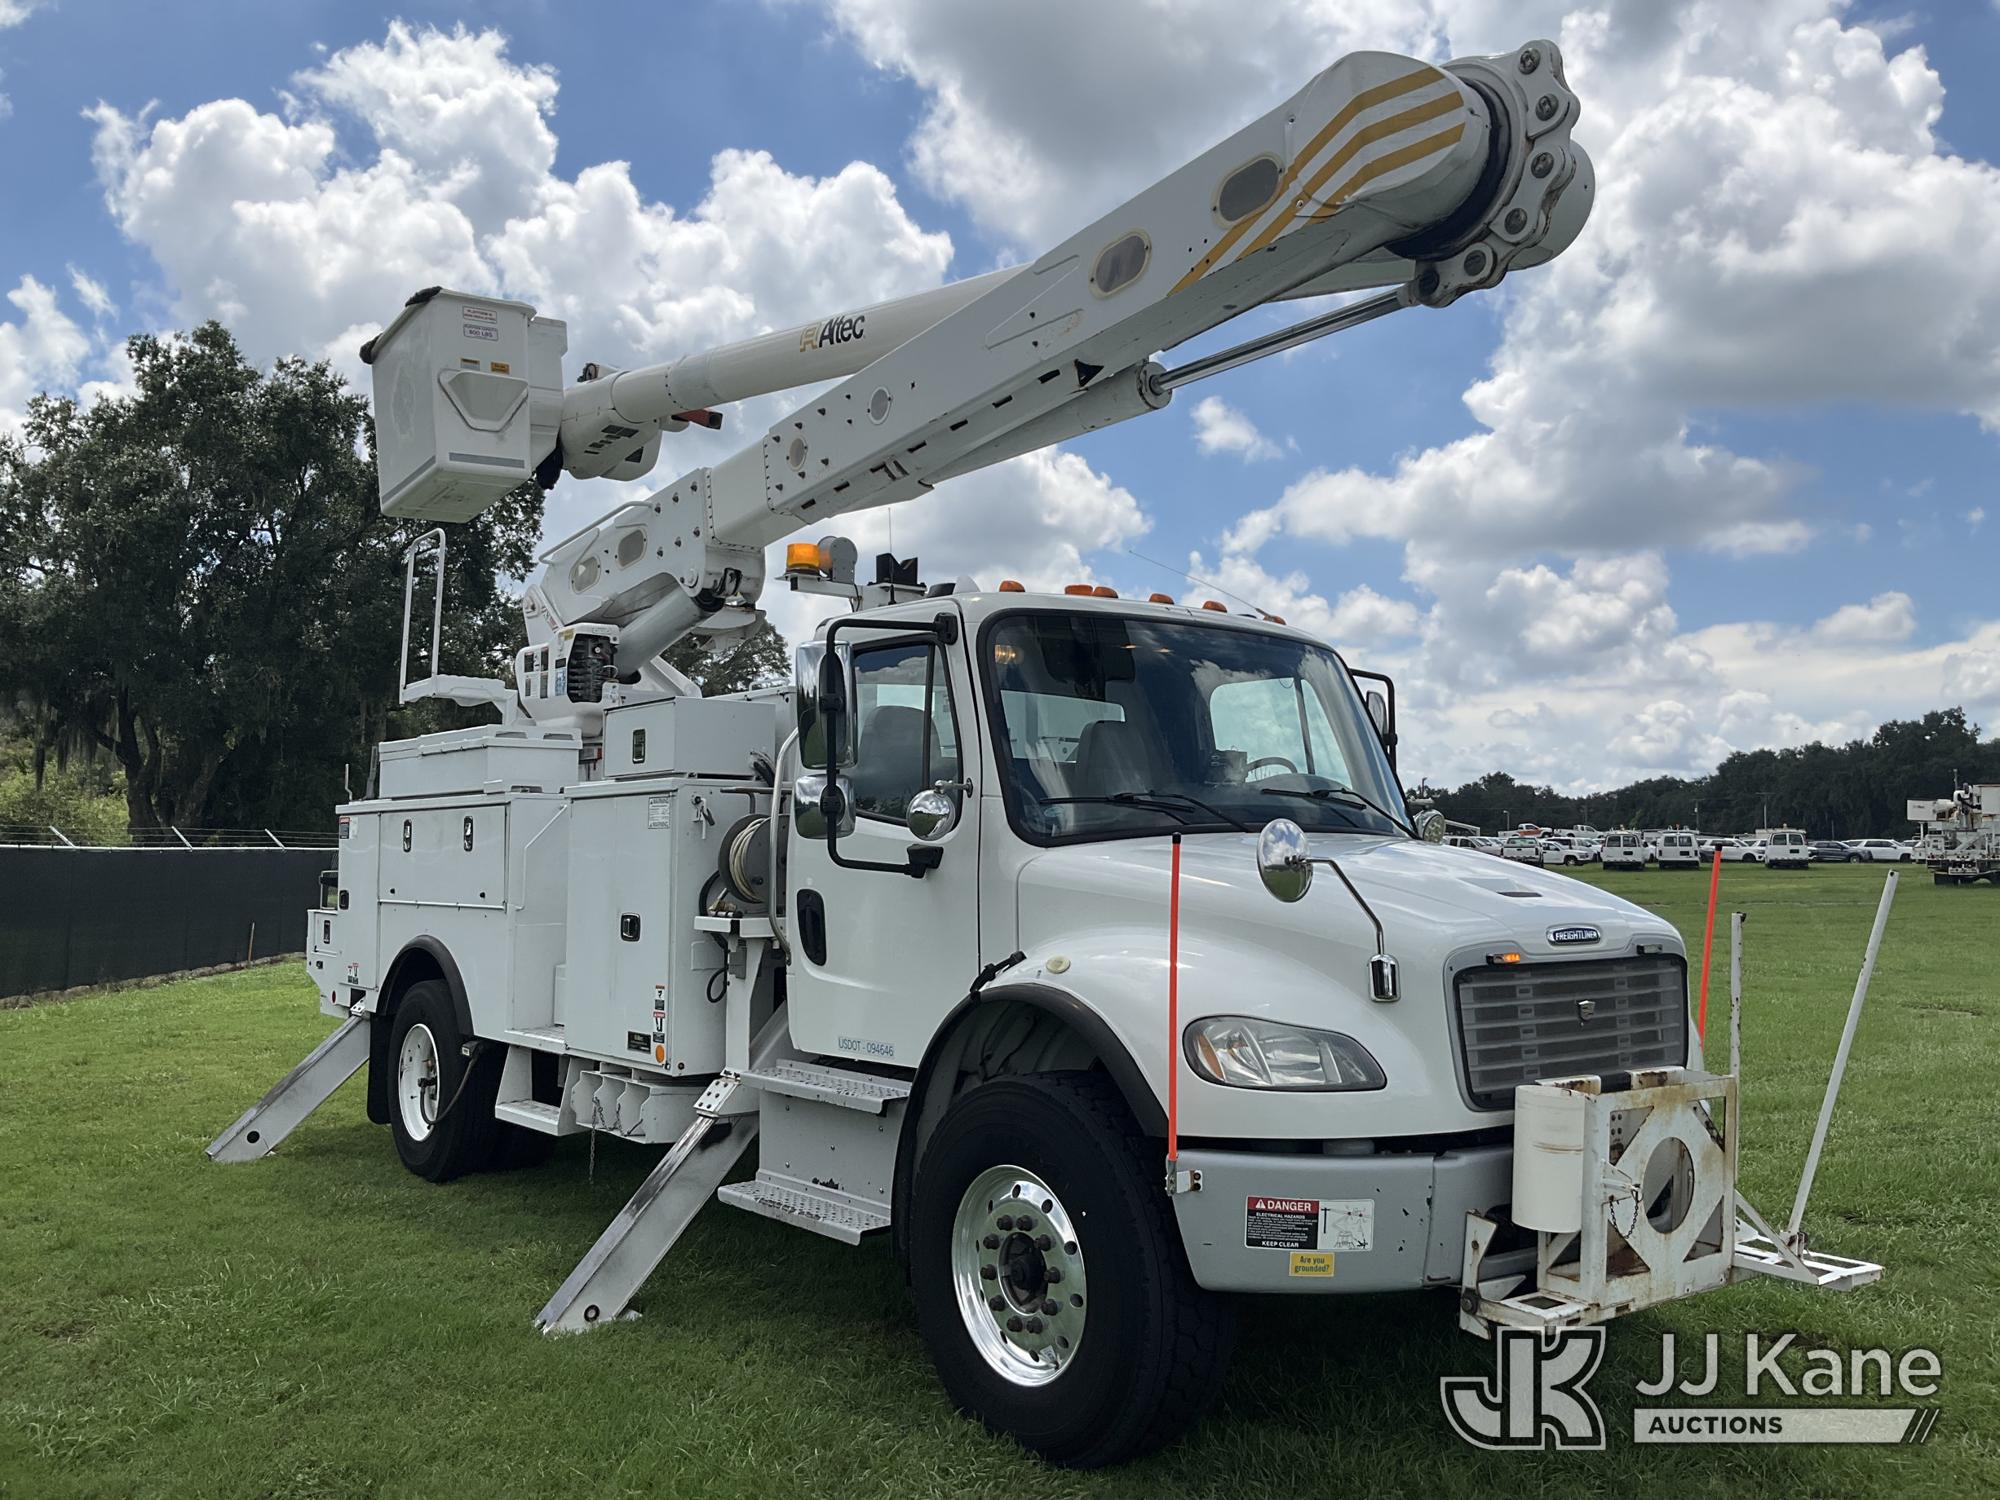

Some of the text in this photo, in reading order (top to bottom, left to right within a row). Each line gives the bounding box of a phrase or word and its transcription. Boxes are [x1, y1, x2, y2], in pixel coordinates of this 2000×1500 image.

[819, 315, 865, 348] Altec
[1555, 930, 1598, 941] FREIGHTLINER
[838, 1036, 860, 1051] USDOT
[866, 1042, 893, 1056] 094646
[1267, 1200, 1311, 1211] DANGER
[1300, 1256, 1325, 1265] Are you
[1294, 1264, 1330, 1273] grounded?
